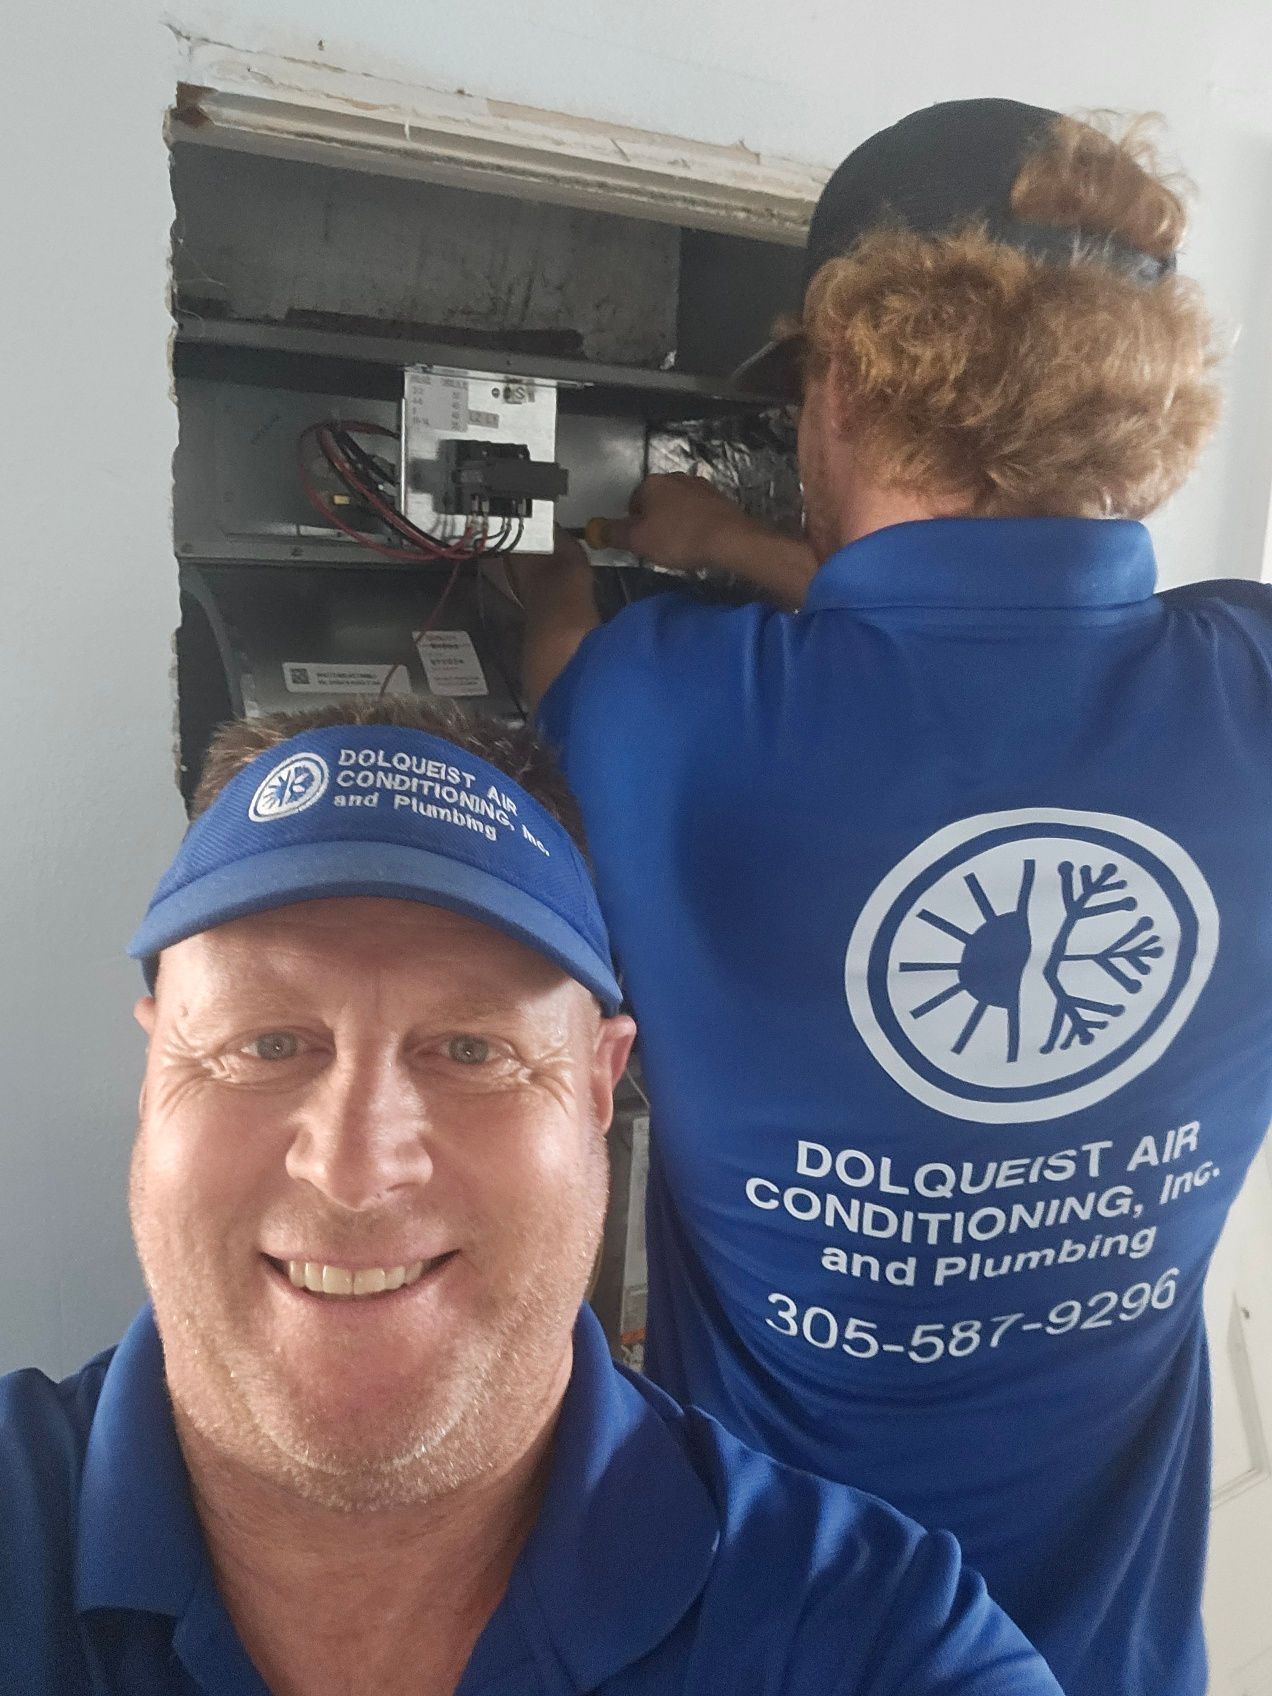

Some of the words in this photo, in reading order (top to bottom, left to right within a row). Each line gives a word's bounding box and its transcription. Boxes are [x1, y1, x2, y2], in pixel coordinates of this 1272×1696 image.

[333, 791, 378, 808] and
[394, 794, 497, 841] Plumbing
[336, 770, 515, 831] CONDITIONING,
[521, 824, 550, 856] Inc.
[339, 749, 475, 788] DOLQUEIST
[487, 785, 518, 816] AIR
[796, 1140, 1113, 1199] DOLQUEIST
[1126, 1121, 1201, 1172] AIR
[745, 1177, 1143, 1245] CONDITIONING,
[1159, 1160, 1220, 1205] Inc.
[821, 1246, 917, 1287] and
[933, 1225, 1157, 1287] Plumbing
[765, 1267, 1181, 1364] 305-587-9296
